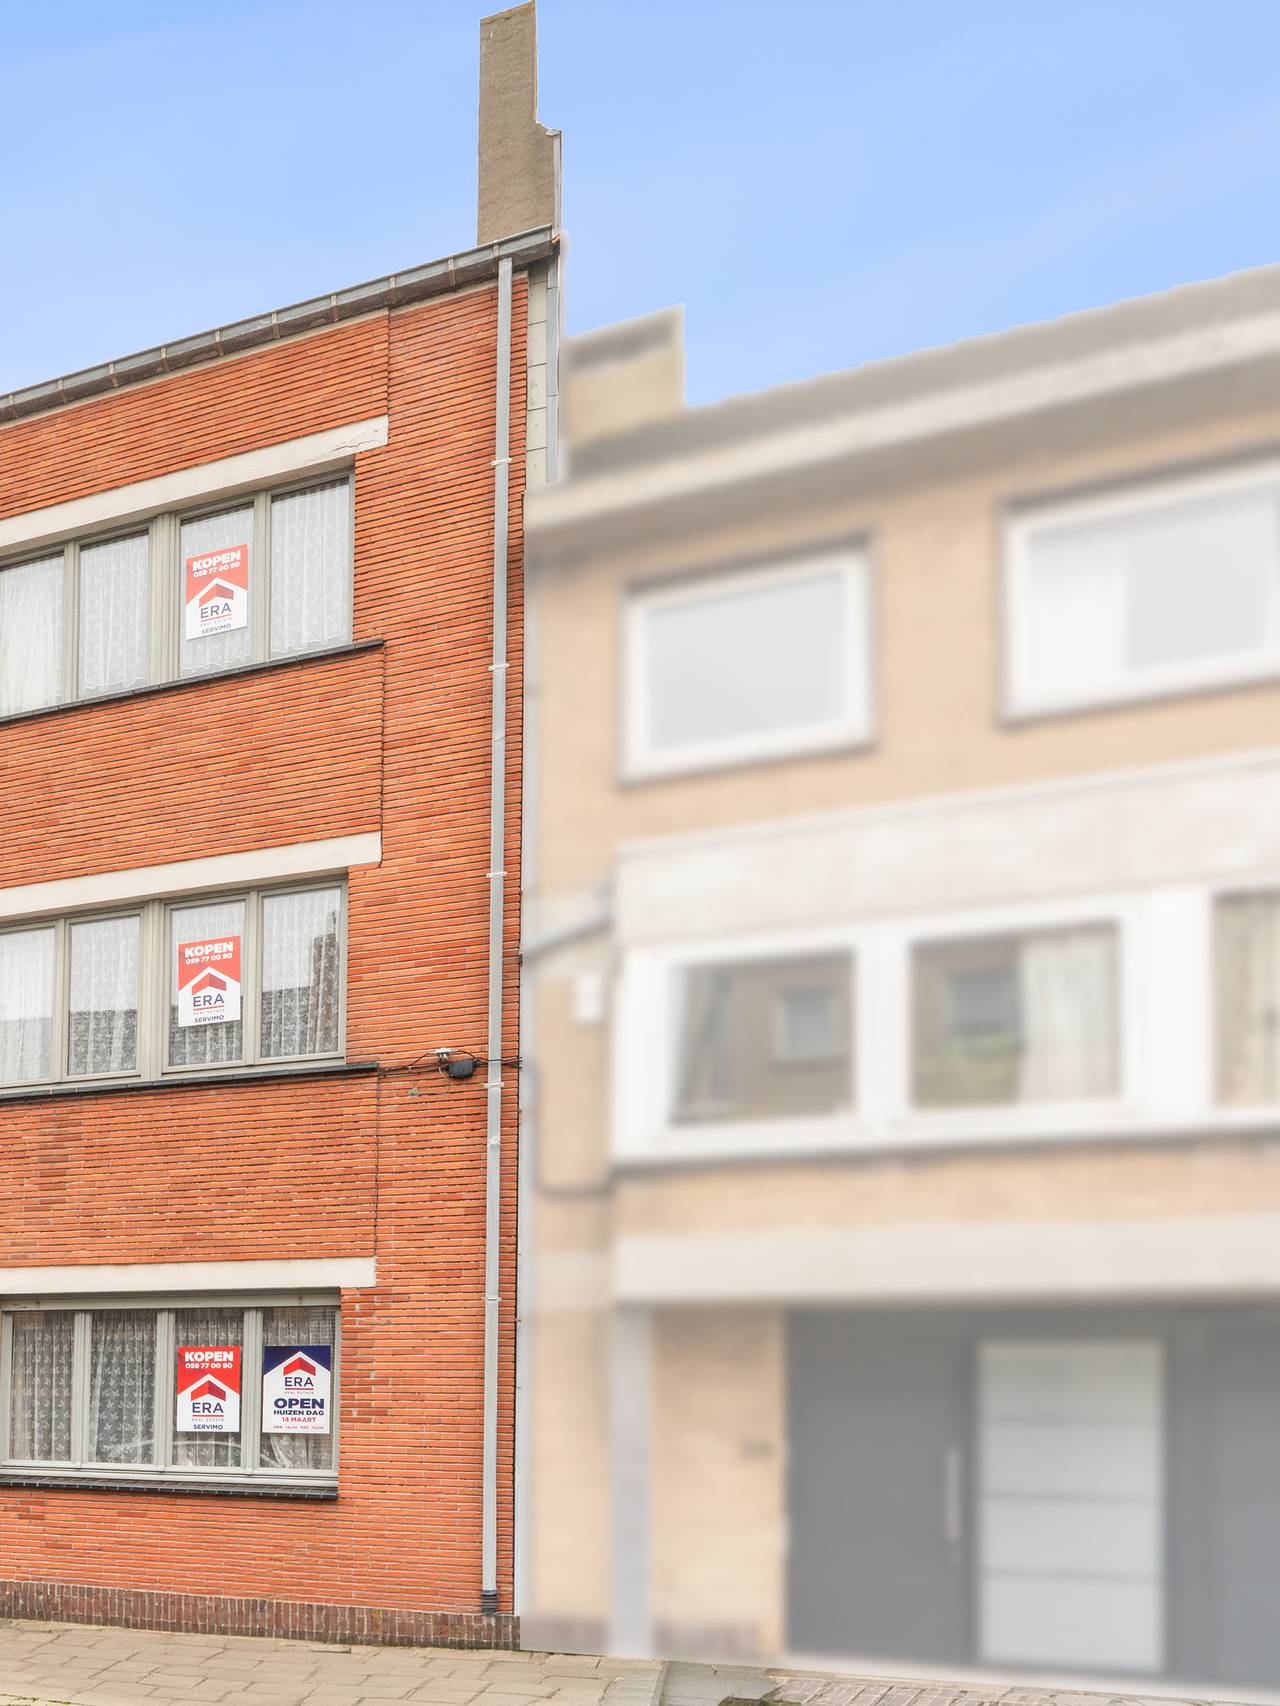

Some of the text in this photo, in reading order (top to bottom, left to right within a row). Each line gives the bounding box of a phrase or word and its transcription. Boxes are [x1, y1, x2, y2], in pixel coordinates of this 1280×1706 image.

[192, 550, 241, 571] KOPEN
[200, 602, 232, 618] ERA
[202, 623, 231, 633] SERVIMO
[184, 941, 234, 958] KOPEN
[193, 993, 224, 1007] ERA
[194, 1014, 224, 1023] SERVIMO
[184, 1351, 234, 1362] KOPEN
[284, 1376, 314, 1387] ERA
[192, 1402, 224, 1413] ERA
[273, 1398, 325, 1409] OPEN
